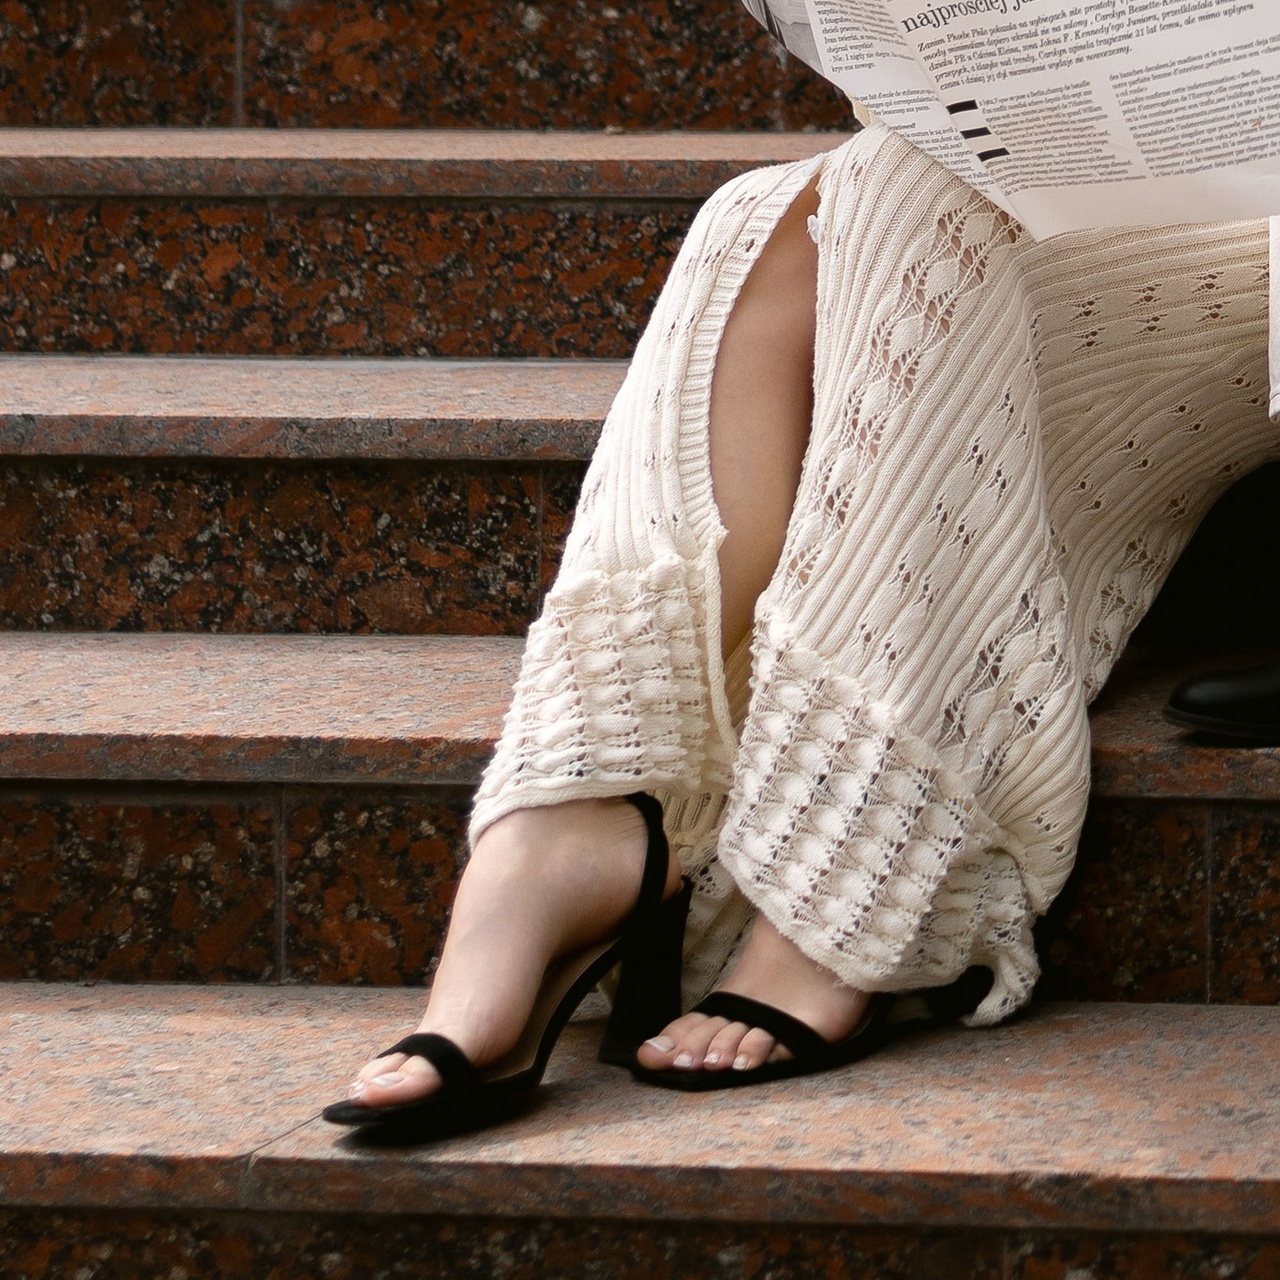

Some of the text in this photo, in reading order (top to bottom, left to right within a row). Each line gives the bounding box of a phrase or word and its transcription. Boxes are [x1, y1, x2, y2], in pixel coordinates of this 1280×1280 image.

[918, 38, 945, 51] Zanim
[1029, 10, 1067, 28] wybiegach
[923, 49, 946, 60] mody
[1063, 21, 1088, 31] salony
[1095, 11, 1126, 24] Carolyn
[954, 55, 966, 64] PR
[1040, 37, 1062, 47] Johna
[1063, 33, 1073, 41] F.
[1126, 16, 1160, 27] Juniora,
[1038, 47, 1067, 59] Carolyn
[1135, 28, 1144, 38] 21
[1146, 25, 1156, 35] lat
[1160, 23, 1182, 32] temu,
[1184, 17, 1196, 26] ale
[1198, 13, 1221, 23] mimo
[1223, 4, 1254, 18] uplywu
